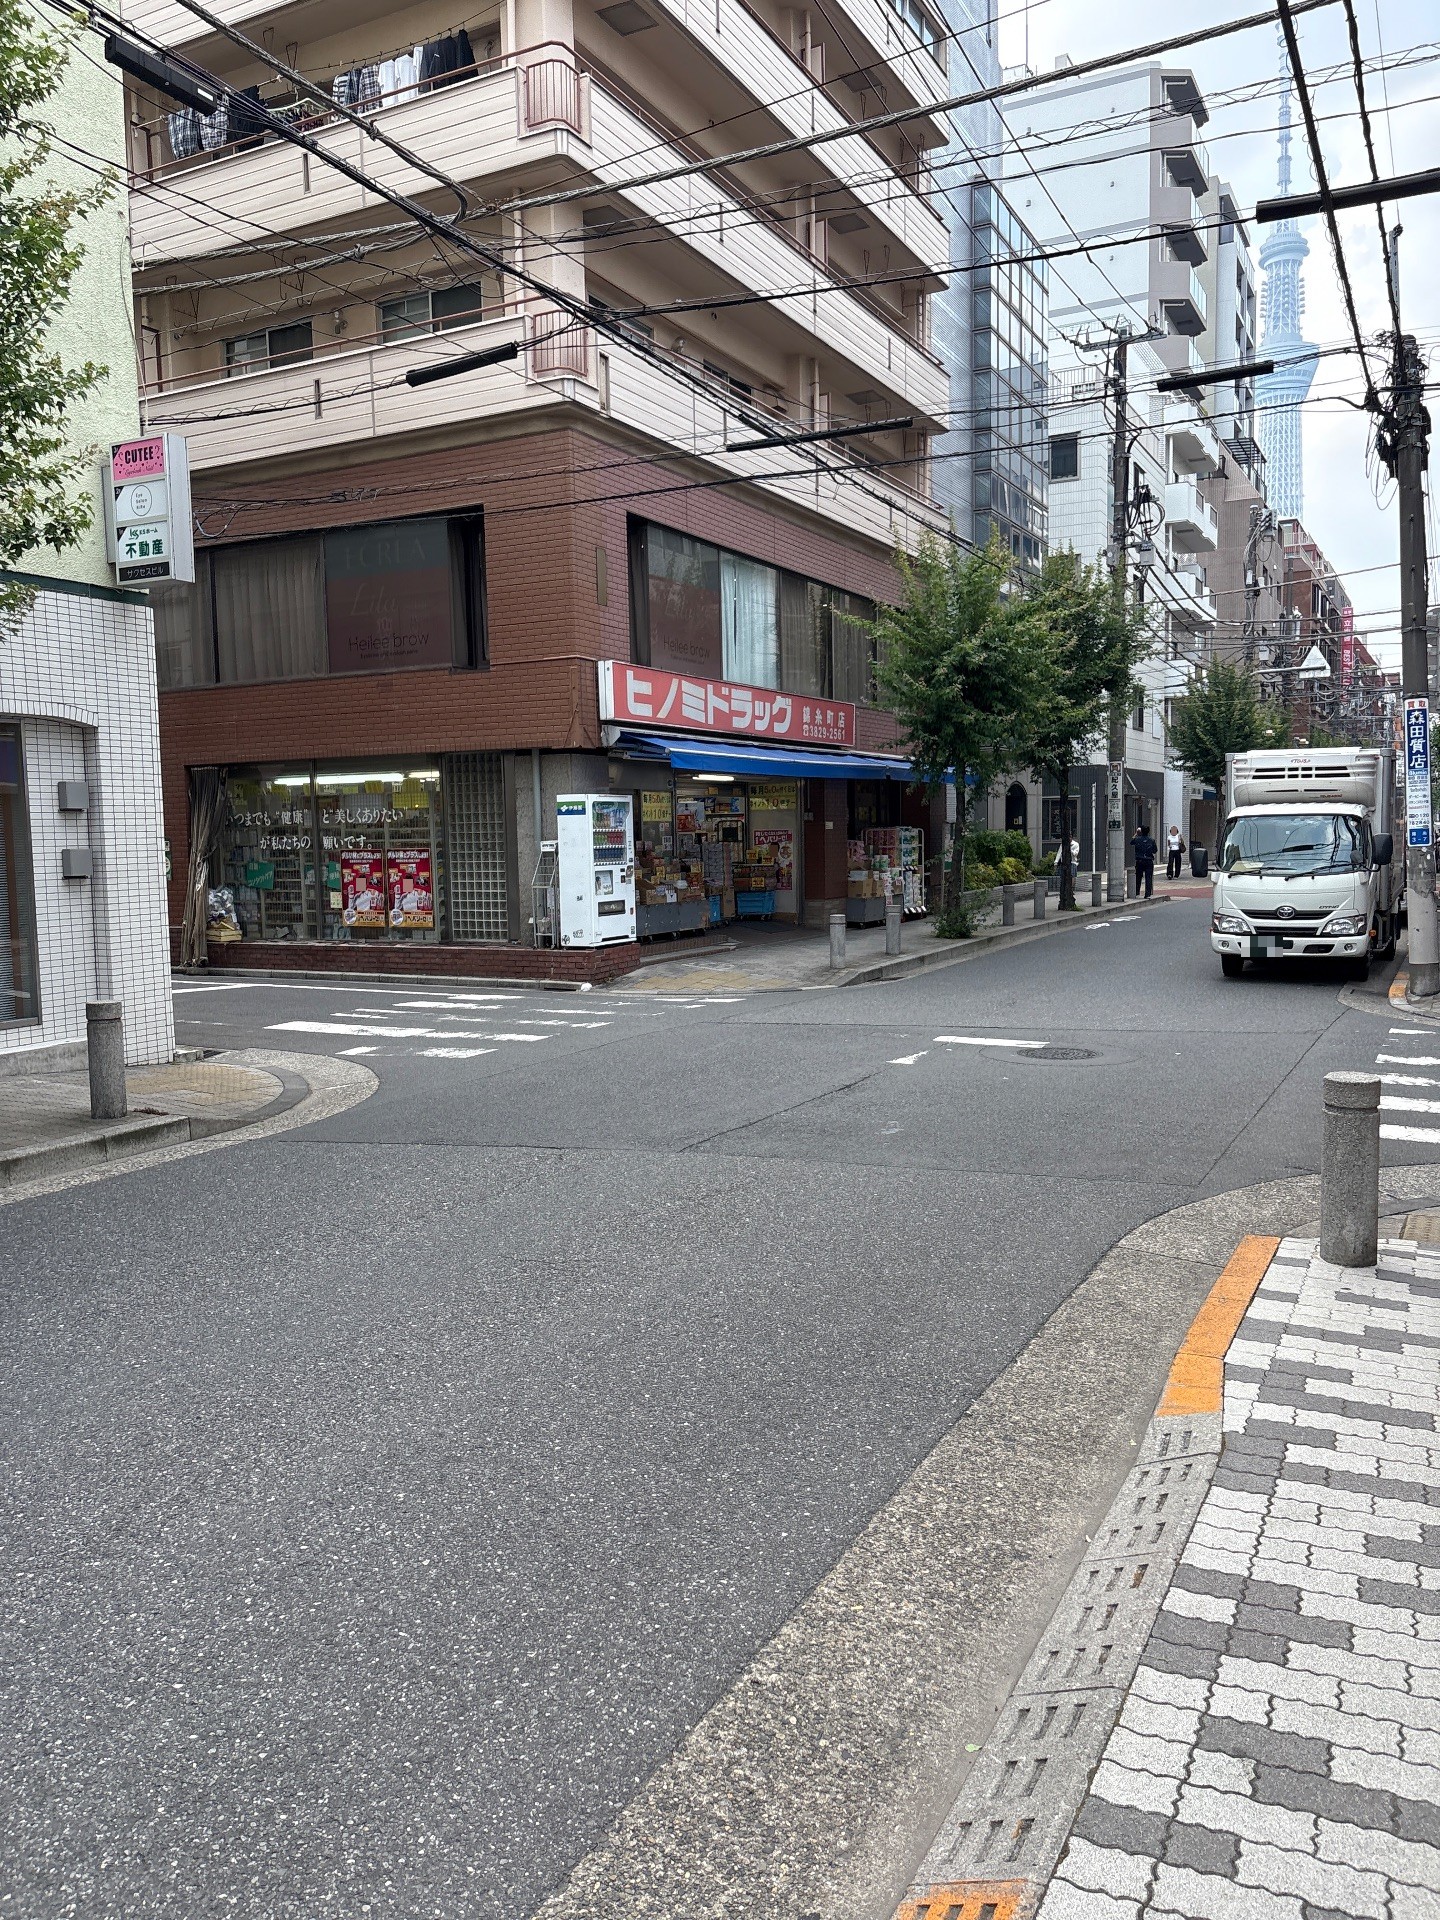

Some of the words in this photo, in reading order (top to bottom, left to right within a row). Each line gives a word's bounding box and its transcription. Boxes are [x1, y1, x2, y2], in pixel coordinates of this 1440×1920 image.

[125, 446, 154, 464] CUTEE
[125, 538, 163, 559] 不動産
[127, 566, 164, 578] サクセスビル
[393, 632, 429, 648] brow
[626, 670, 792, 734] ヒノミドラッグ
[803, 705, 846, 729] 錦糸町店
[809, 727, 846, 741] 3829-2561
[1408, 711, 1426, 769] 森田質店
